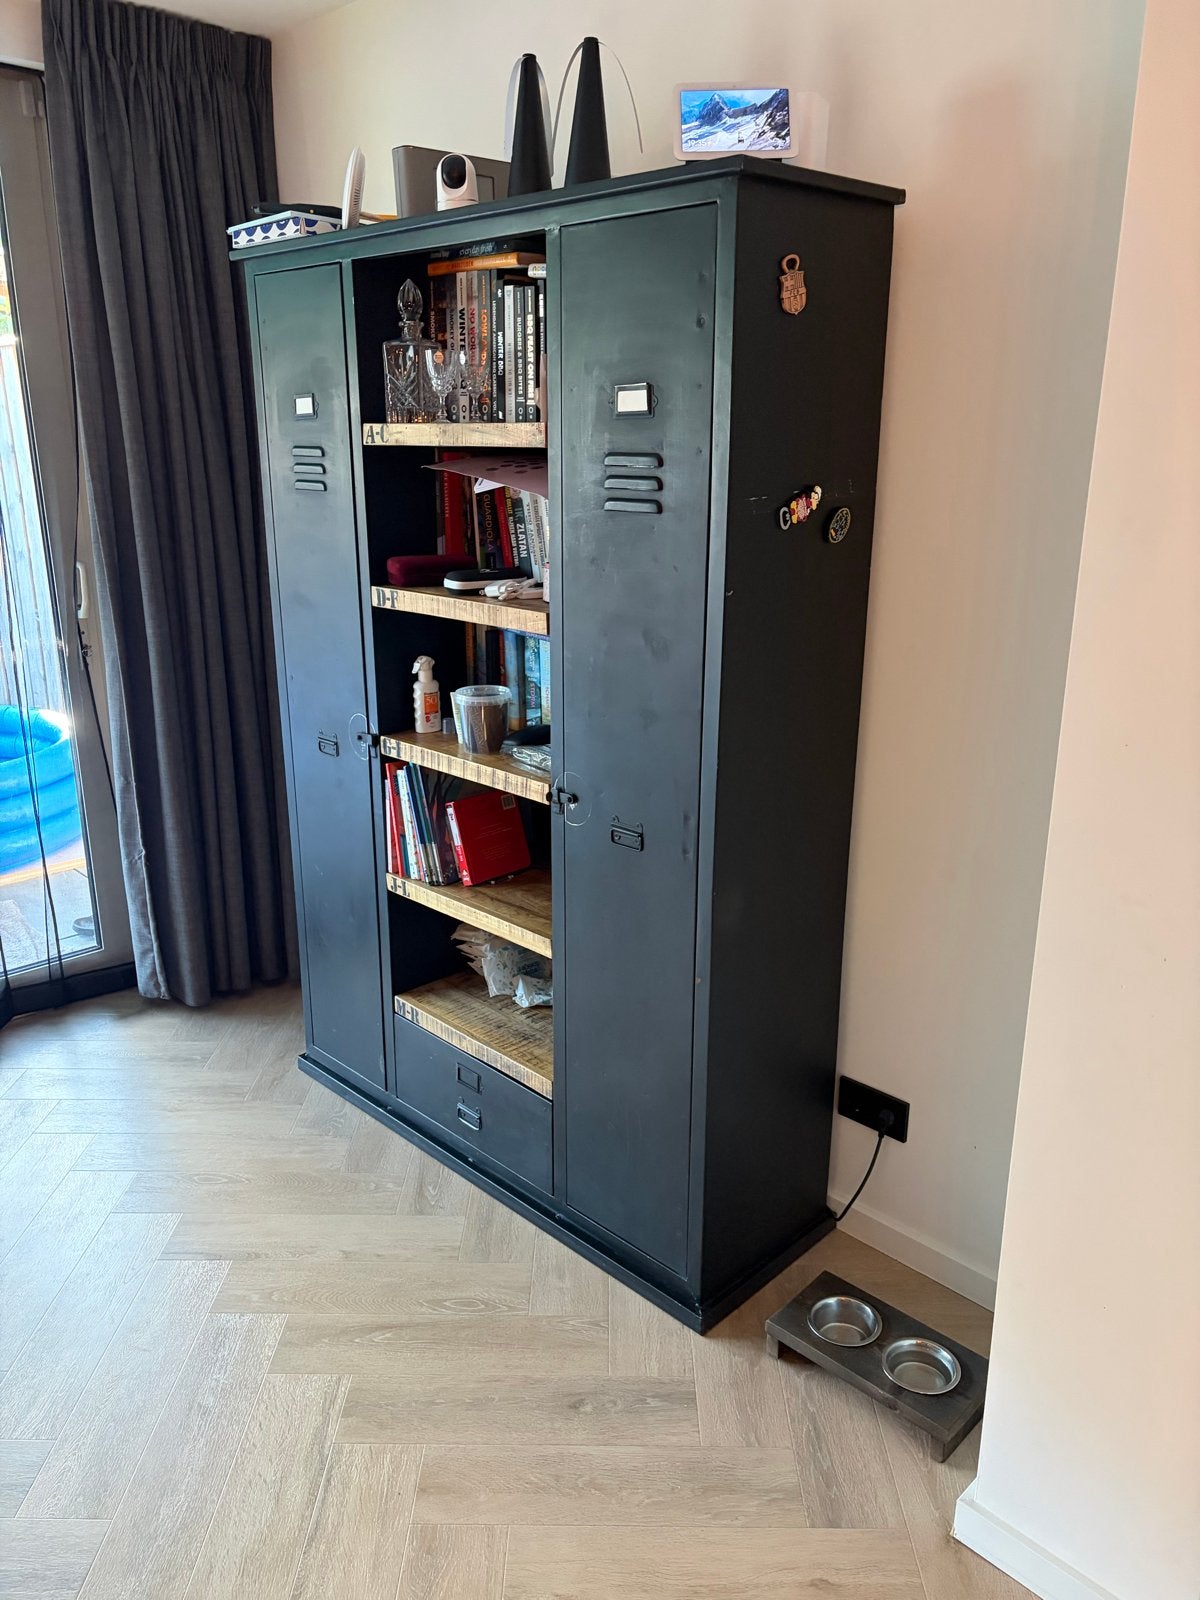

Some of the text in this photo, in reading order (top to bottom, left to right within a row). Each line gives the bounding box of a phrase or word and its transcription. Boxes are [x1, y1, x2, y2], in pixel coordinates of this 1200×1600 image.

[470, 308, 476, 324] NO
[527, 363, 534, 379] ON
[527, 380, 535, 398] FIRE
[365, 424, 389, 444] A-C
[482, 494, 494, 551] GUARDIOLA
[516, 523, 527, 557] ZLATAN
[424, 694, 438, 704] 50
[390, 877, 410, 898] J-L
